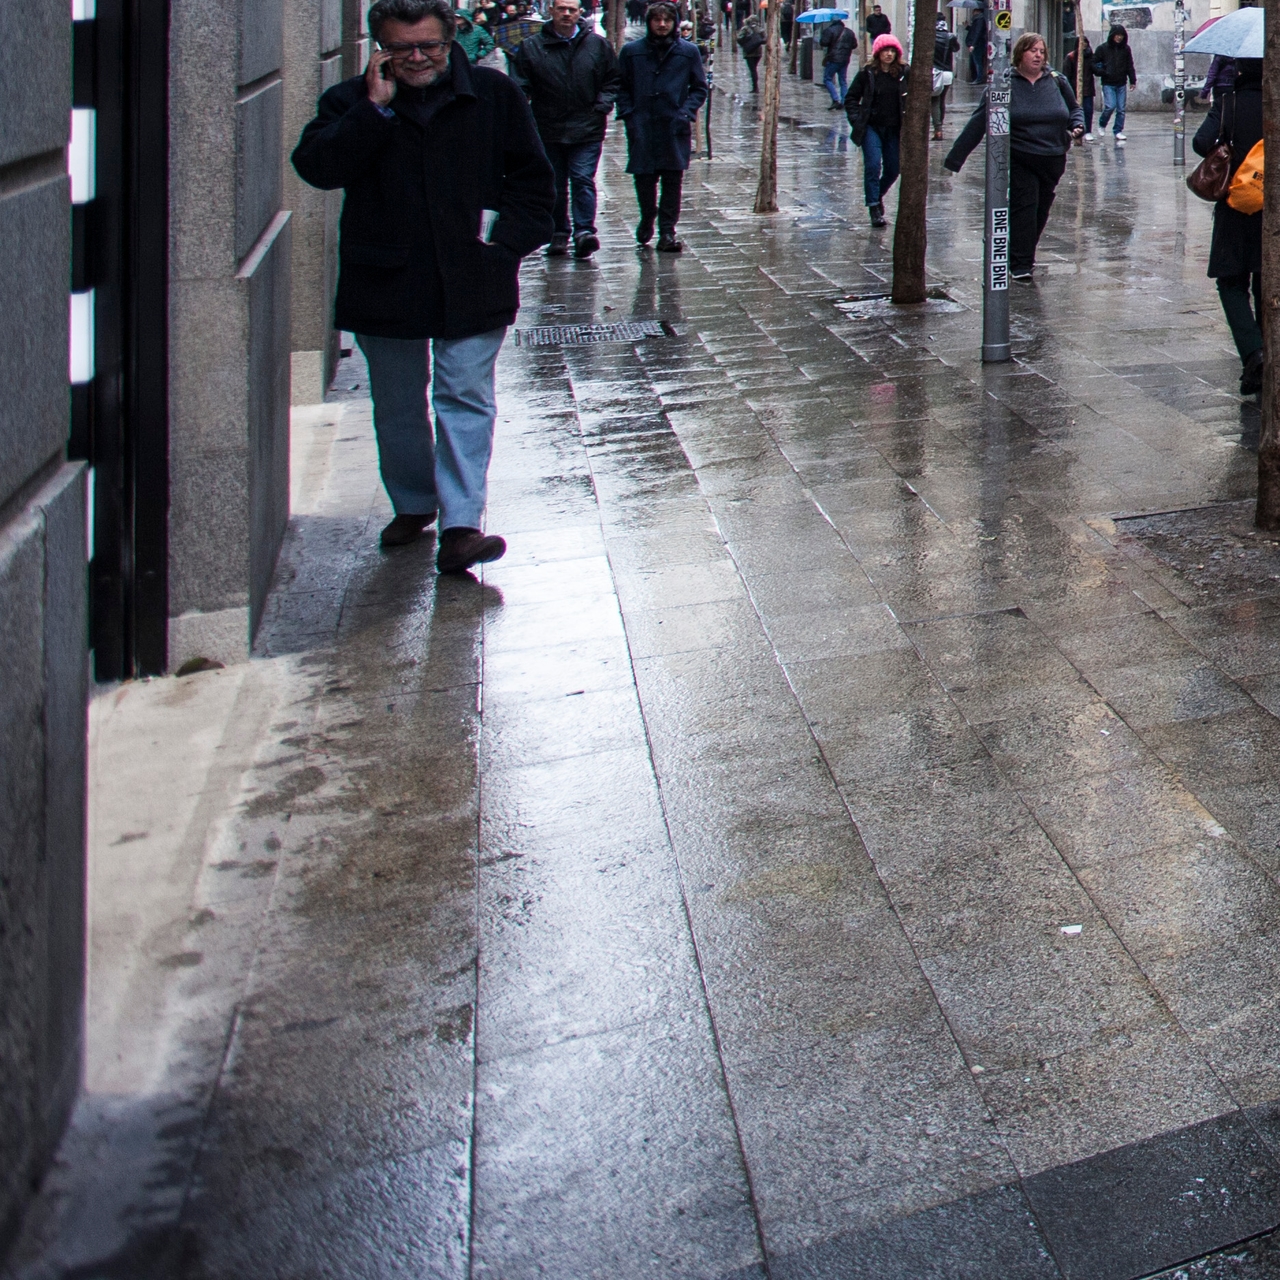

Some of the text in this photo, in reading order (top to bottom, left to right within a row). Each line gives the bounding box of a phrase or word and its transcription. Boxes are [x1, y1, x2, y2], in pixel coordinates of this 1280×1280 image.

[994, 209, 1008, 234] BNE
[993, 237, 1007, 261] BNE
[993, 265, 1006, 289] BNE
